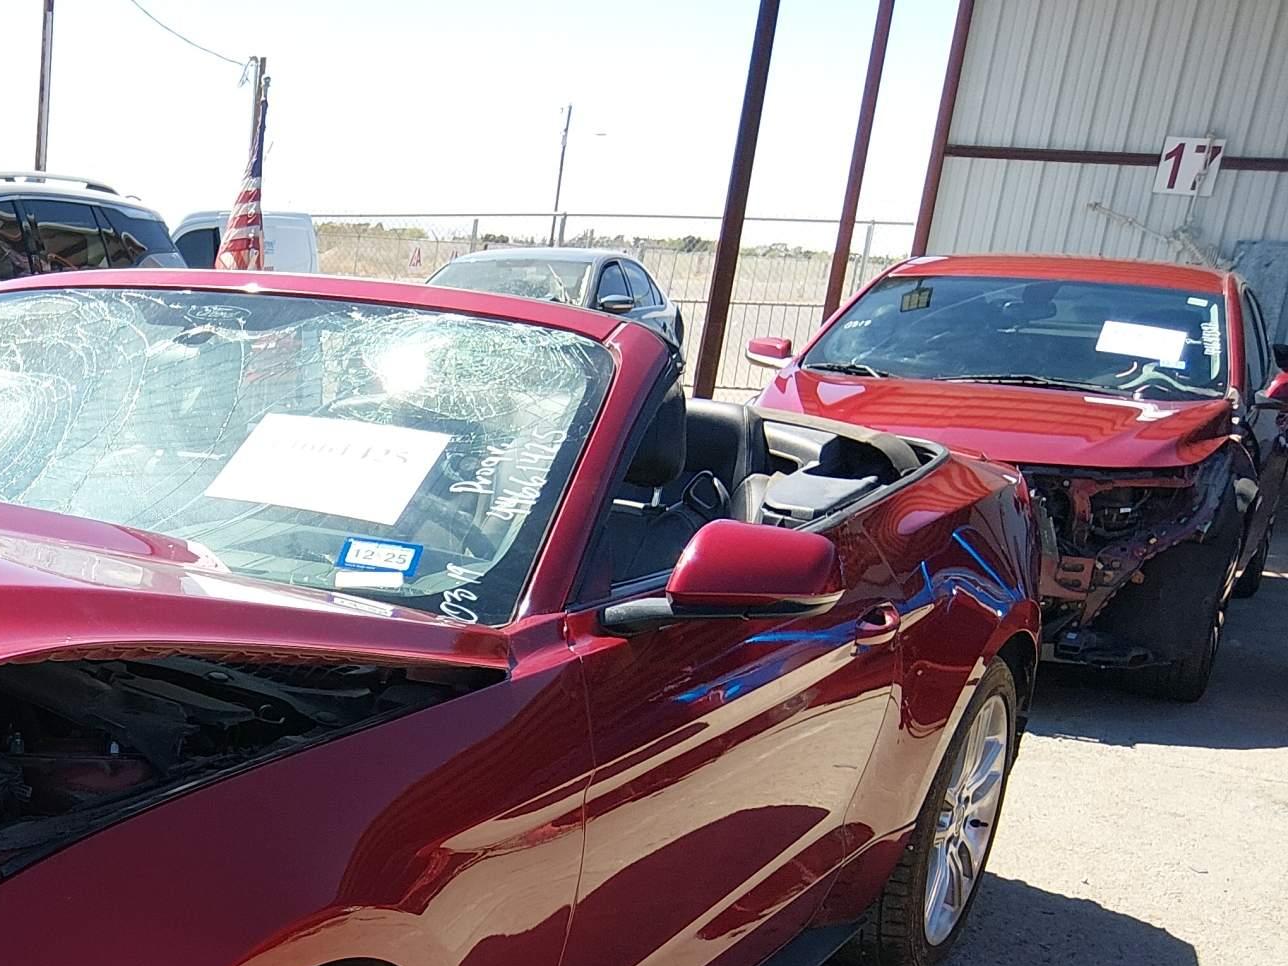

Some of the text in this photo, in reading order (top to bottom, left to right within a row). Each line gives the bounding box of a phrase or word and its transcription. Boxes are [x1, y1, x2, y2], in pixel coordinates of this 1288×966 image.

[1164, 142, 1223, 191] 17
[486, 428, 568, 521] 44661425
[354, 549, 408, 565] 12 25
